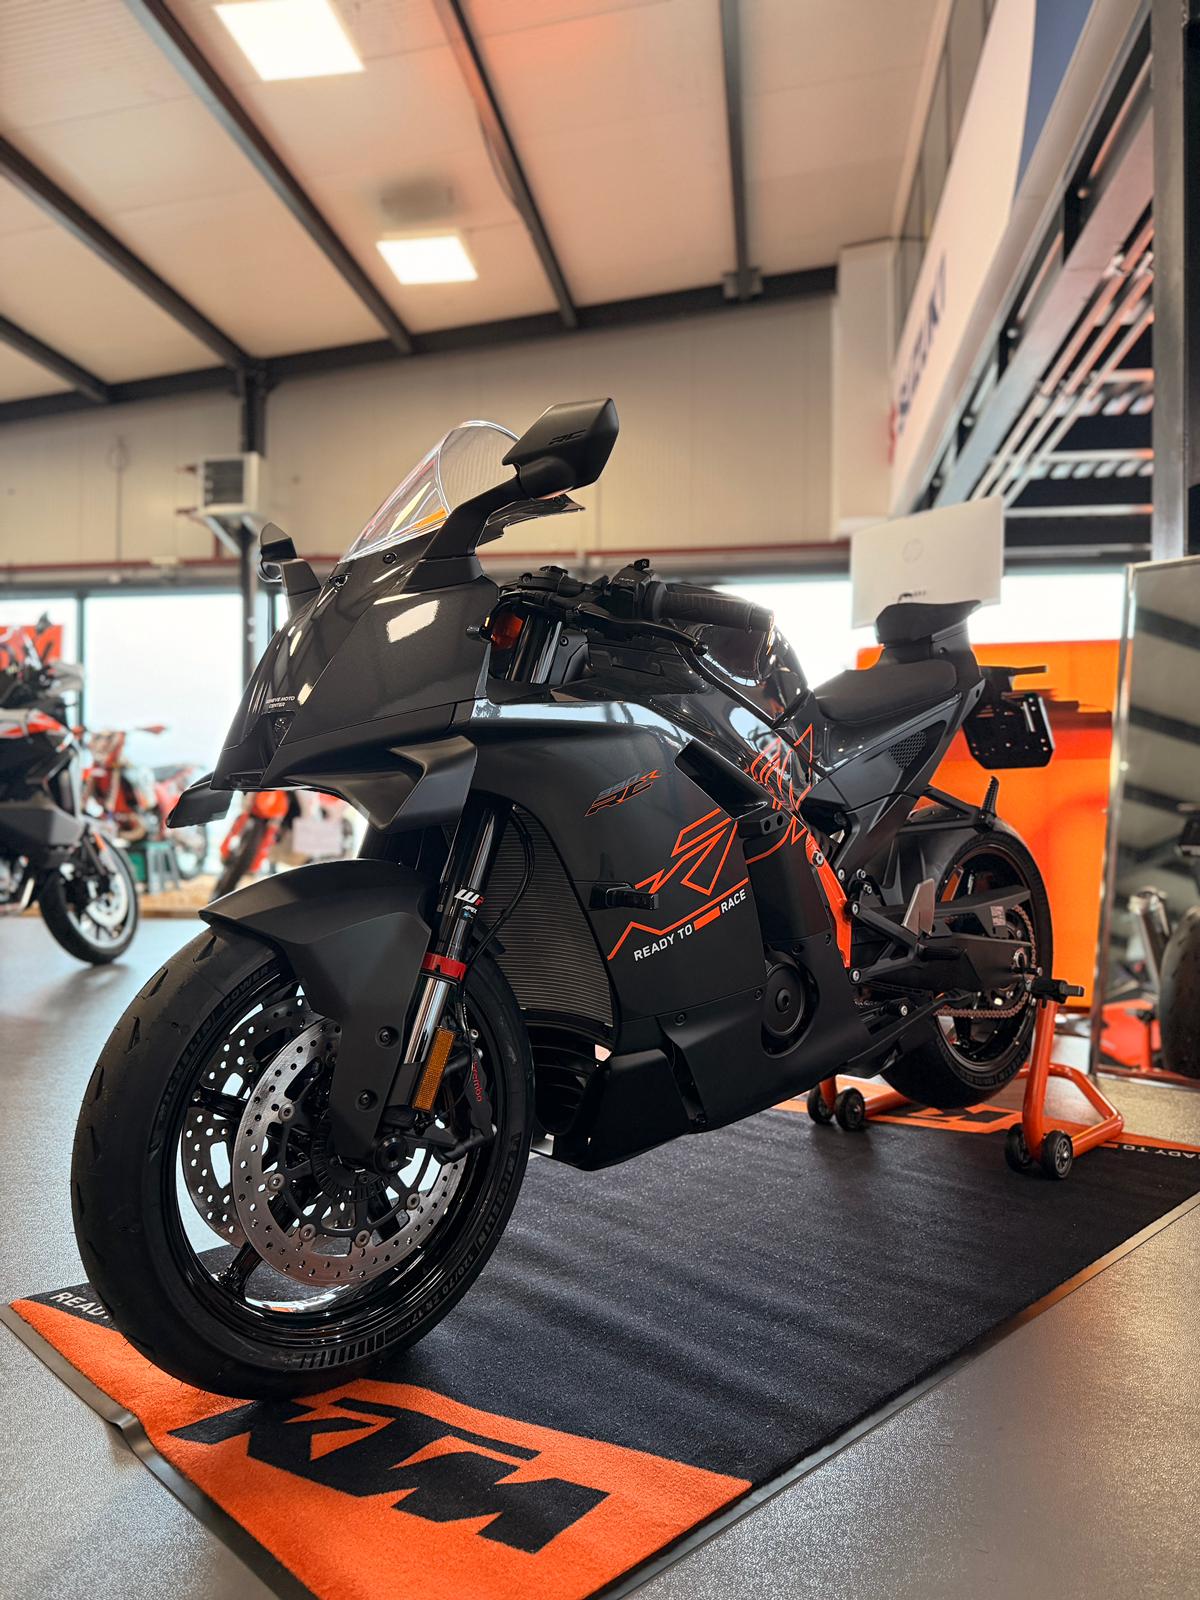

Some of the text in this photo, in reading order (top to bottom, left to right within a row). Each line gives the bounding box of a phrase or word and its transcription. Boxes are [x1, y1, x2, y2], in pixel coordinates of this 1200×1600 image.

[633, 889, 747, 962] READY TO RACE
[220, 964, 271, 1009] POWER
[1122, 1144, 1148, 1153] TO
[440, 1252, 475, 1294] 120/70
[410, 1308, 425, 1324] 17
[167, 1396, 610, 1554] KTM
